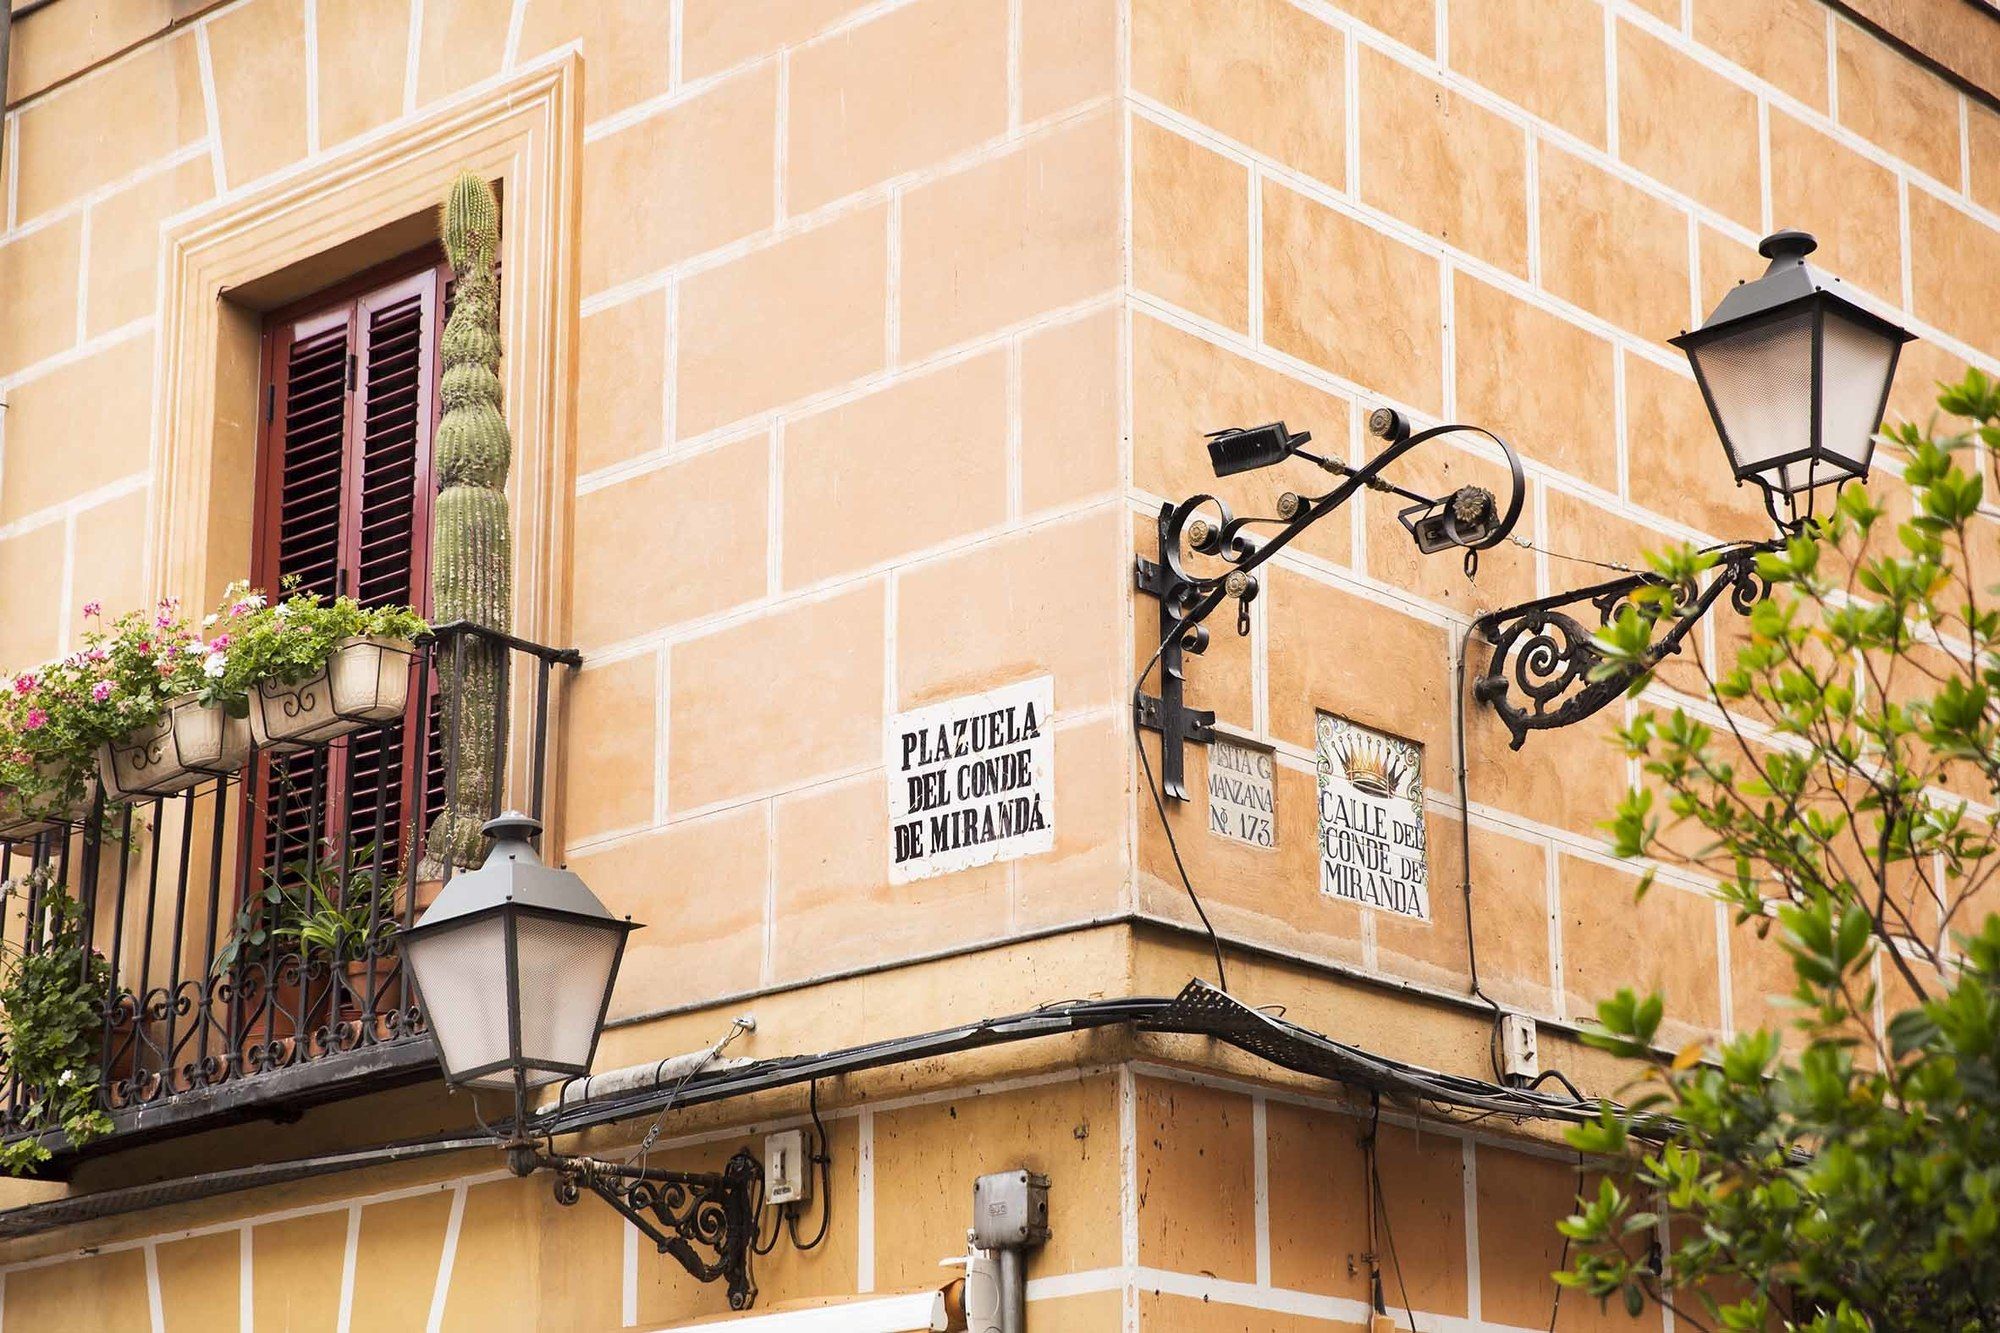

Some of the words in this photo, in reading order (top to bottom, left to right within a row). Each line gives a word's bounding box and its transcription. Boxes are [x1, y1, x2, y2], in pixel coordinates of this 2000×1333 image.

[901, 701, 1041, 772] PLAZUELA
[1208, 741, 1253, 775] ISITA
[907, 769, 951, 814] DEL
[957, 749, 1032, 801] CONDE
[894, 820, 924, 863] DE
[1321, 789, 1387, 840] CALLE
[1393, 820, 1426, 852] DEL
[1326, 827, 1392, 875] CONDE
[1401, 857, 1422, 884] DE
[1325, 860, 1424, 918] MIRANDA
